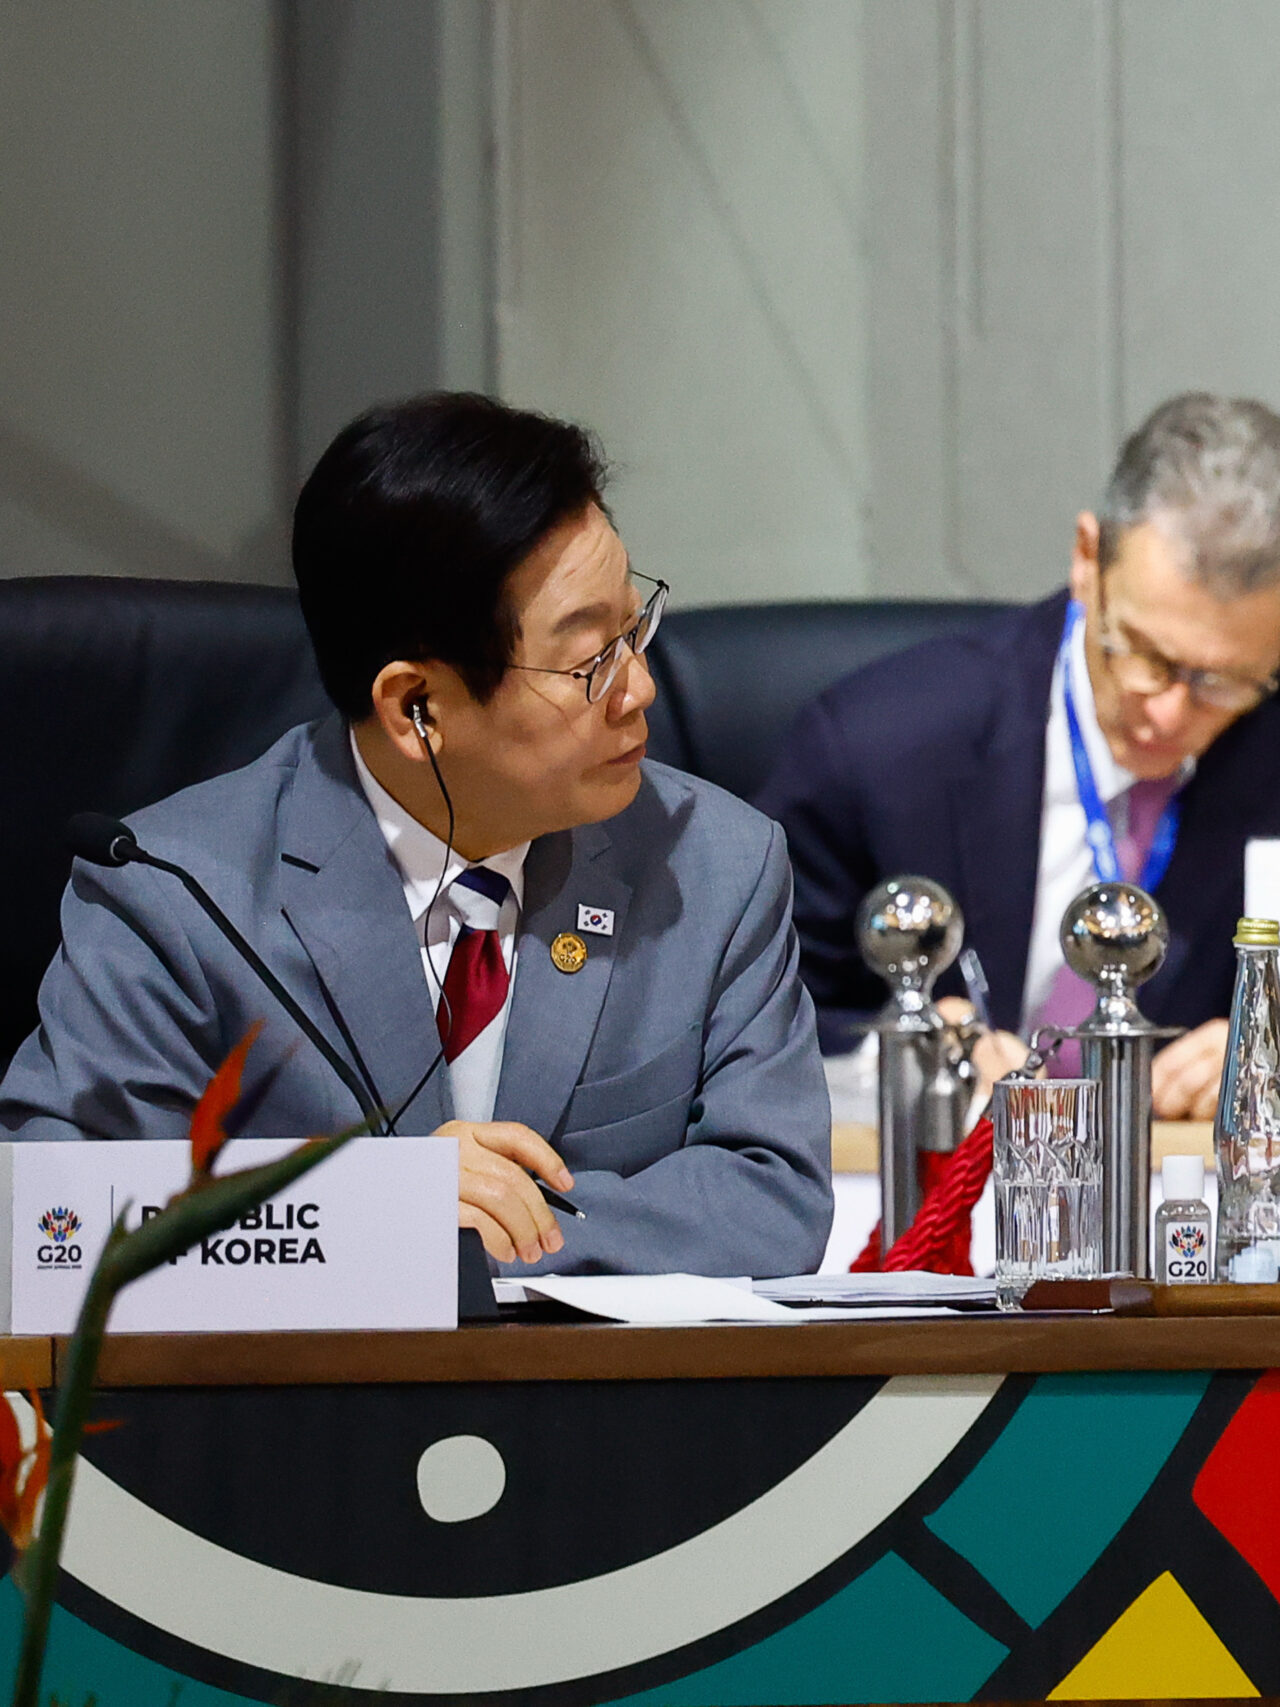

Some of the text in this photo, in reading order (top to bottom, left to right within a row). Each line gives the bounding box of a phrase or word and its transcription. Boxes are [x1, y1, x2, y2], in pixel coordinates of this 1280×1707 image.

[142, 1204, 320, 1231] BLIC
[37, 1244, 82, 1263] G20
[201, 1238, 326, 1265] KOREA
[1168, 1260, 1207, 1277] G20
